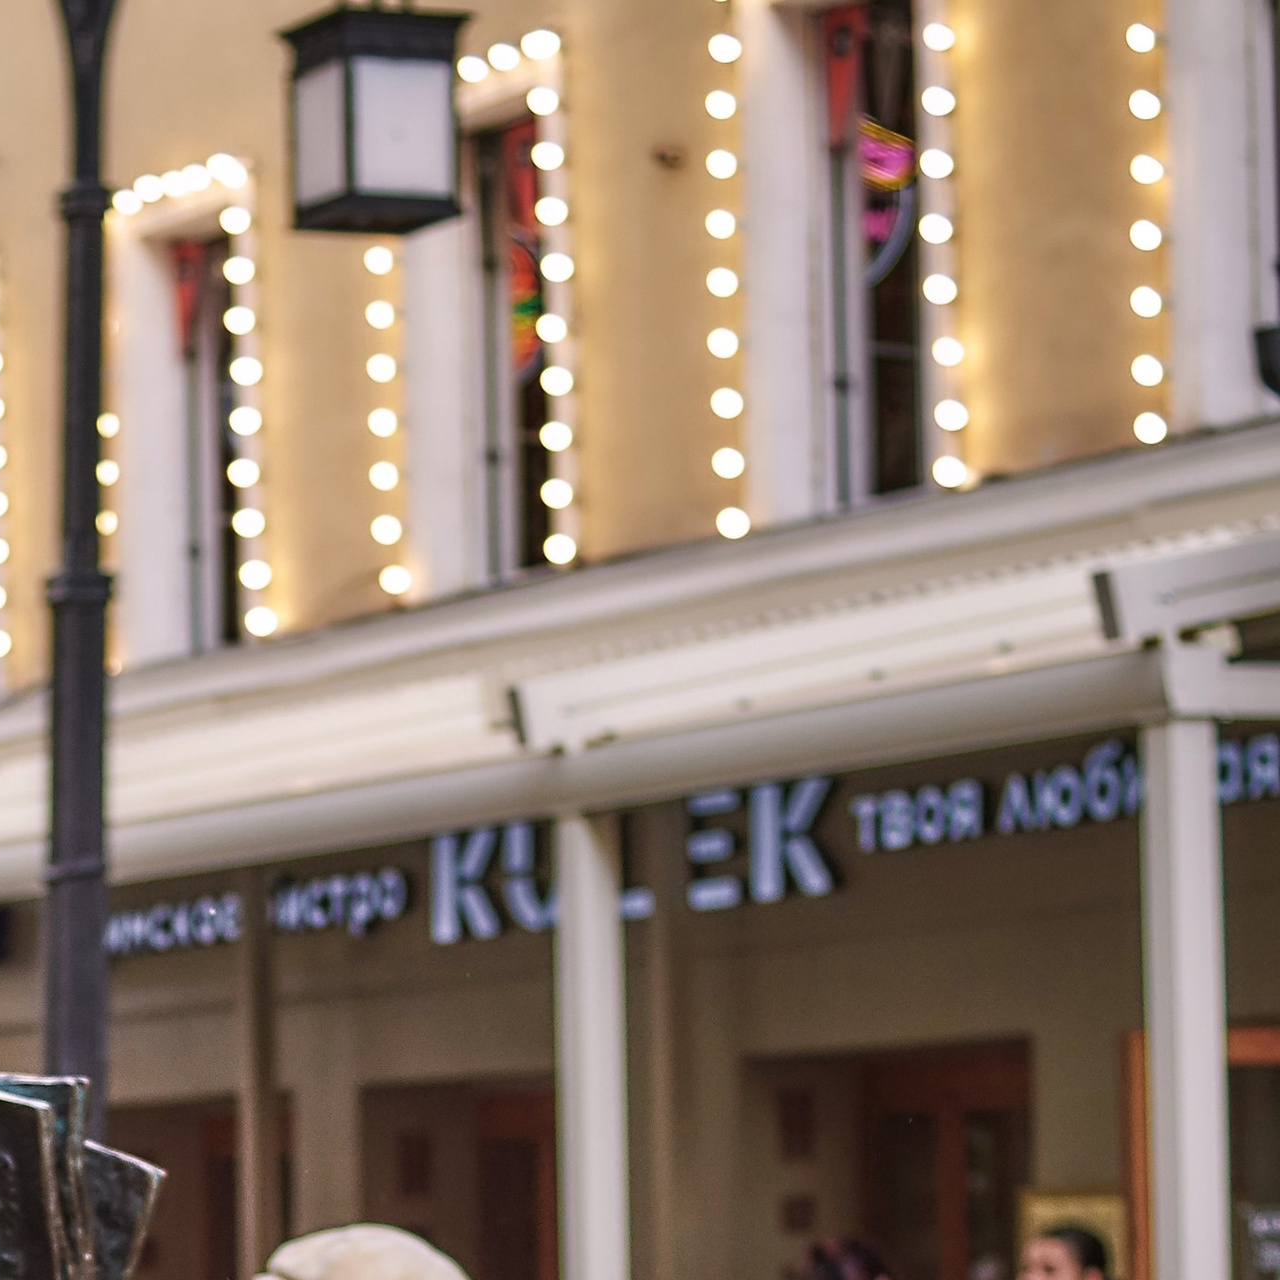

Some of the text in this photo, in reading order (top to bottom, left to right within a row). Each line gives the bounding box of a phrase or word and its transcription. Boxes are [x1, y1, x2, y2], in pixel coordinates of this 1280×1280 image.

[999, 733, 1280, 832] любиая
[102, 867, 407, 952] инское истро
